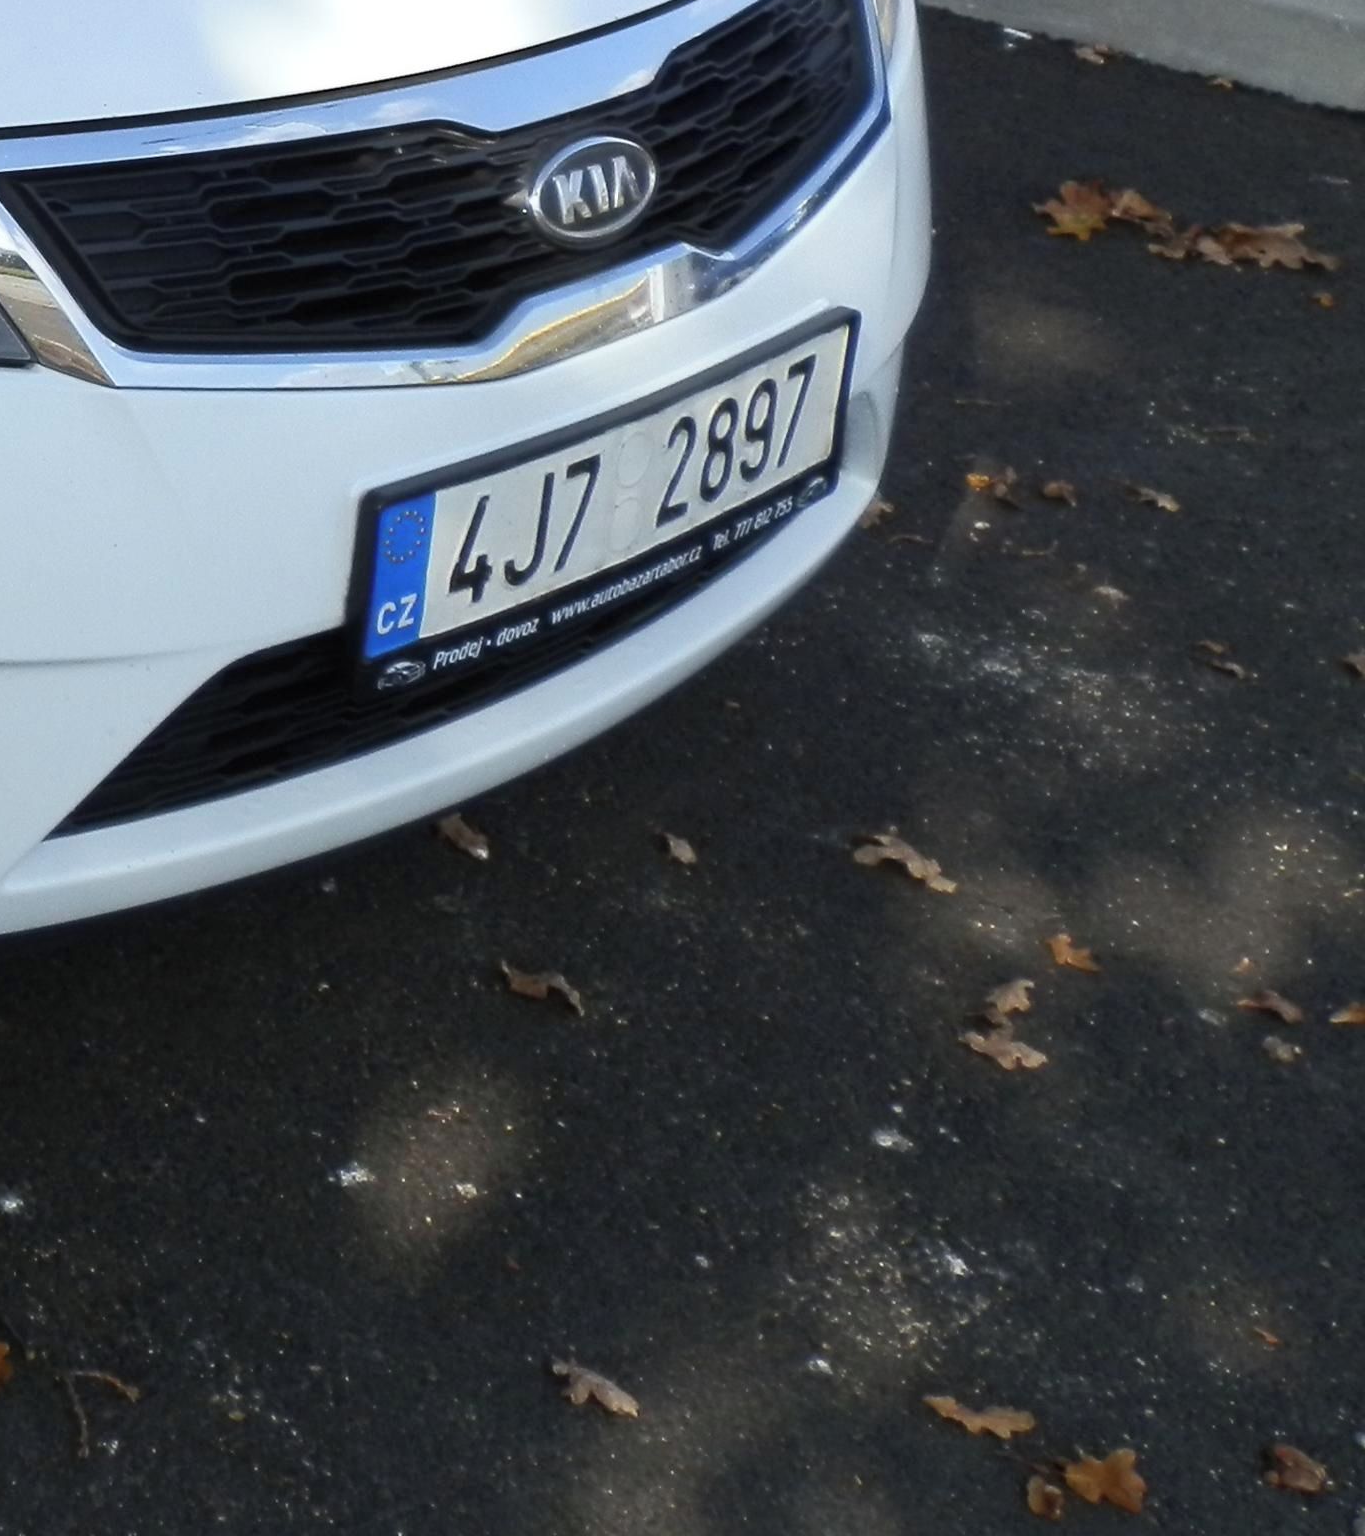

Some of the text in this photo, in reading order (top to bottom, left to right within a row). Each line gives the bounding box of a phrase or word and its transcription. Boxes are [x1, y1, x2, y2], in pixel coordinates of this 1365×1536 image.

[551, 155, 641, 226] KIA
[447, 354, 817, 604] 4J7 2897
[376, 592, 418, 636] CZ
[433, 636, 484, 670] Prodej
[496, 617, 540, 647] dovoz
[550, 545, 703, 625] www.autobazartabor.cz
